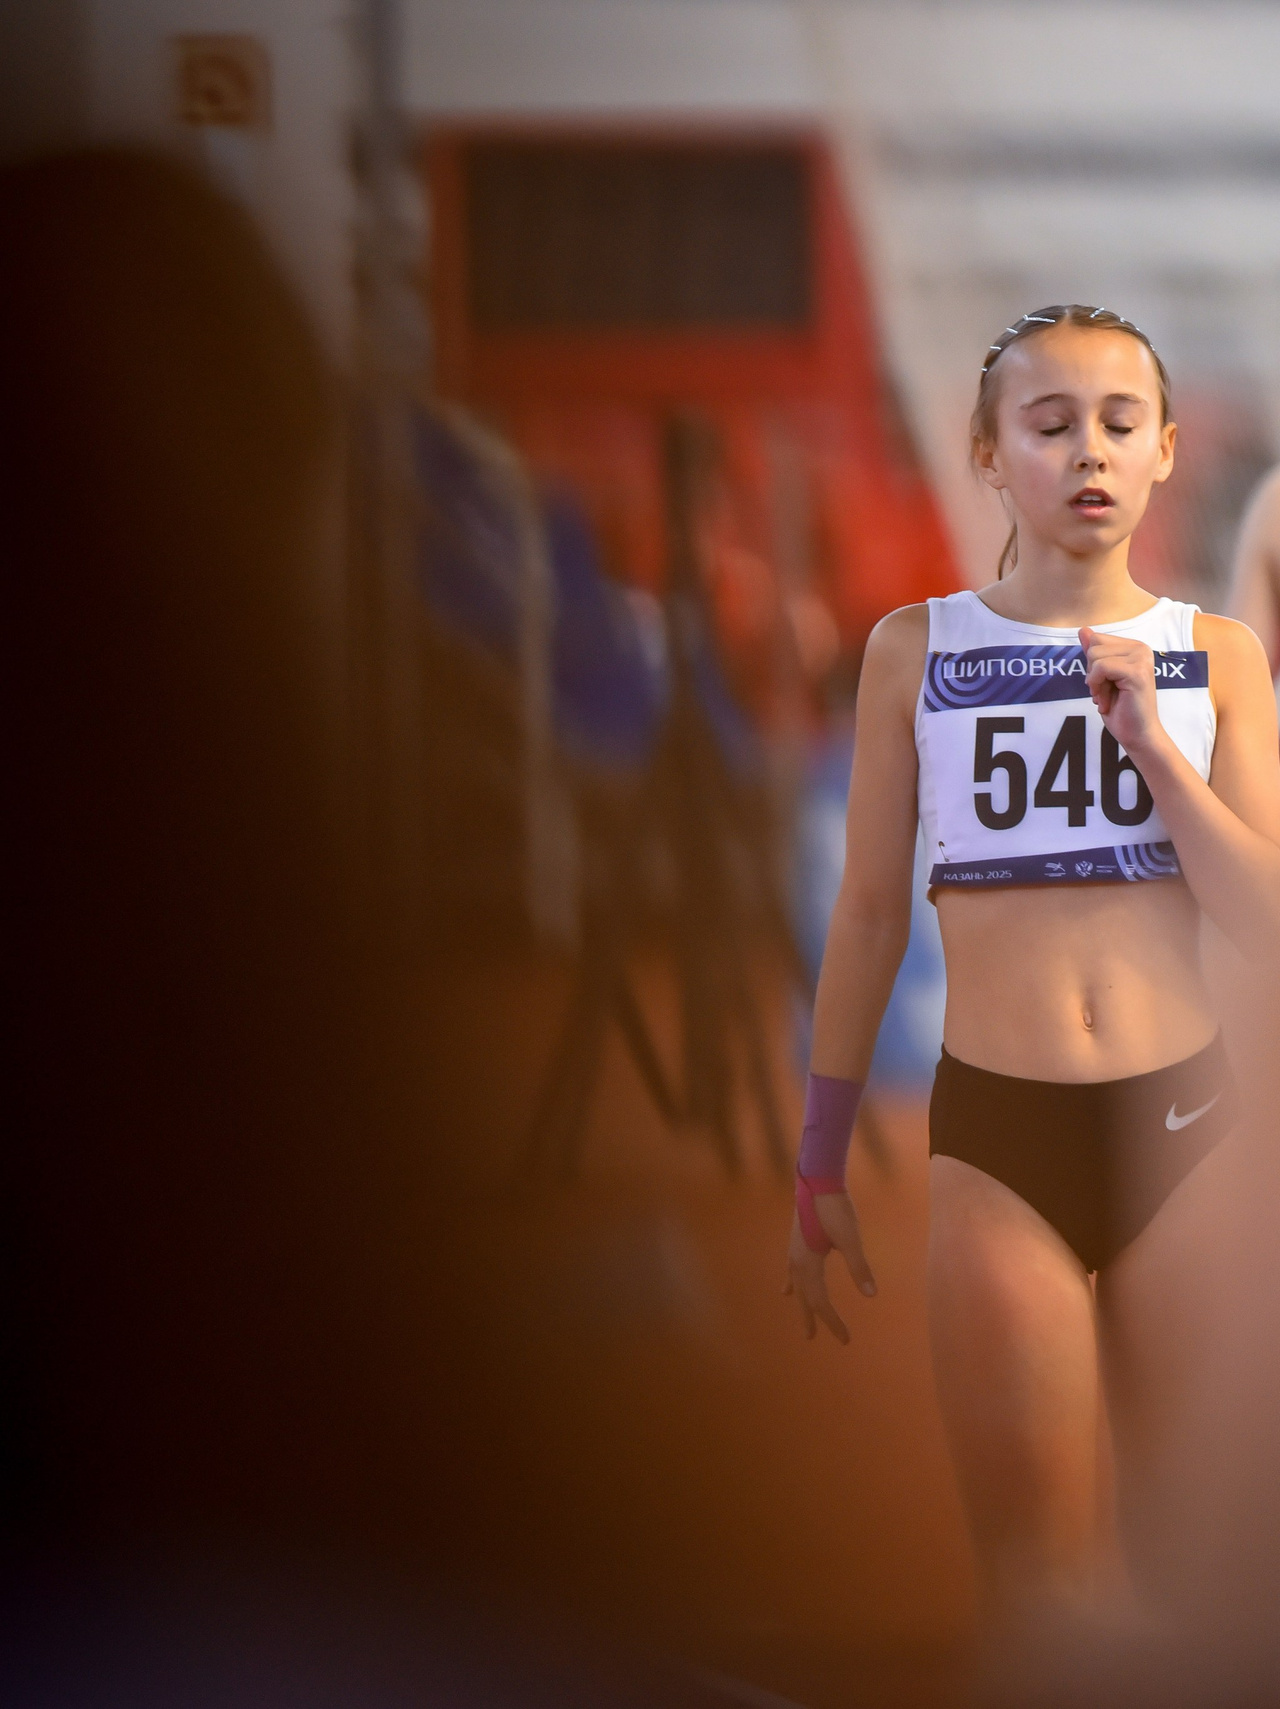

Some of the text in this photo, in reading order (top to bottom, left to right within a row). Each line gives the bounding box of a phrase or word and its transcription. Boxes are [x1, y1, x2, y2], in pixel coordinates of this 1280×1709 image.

[943, 657, 1187, 680] ШИПОВКА ЫХ
[973, 715, 1154, 831] 546
[943, 870, 1013, 881] КАЗАНЬ 2025
